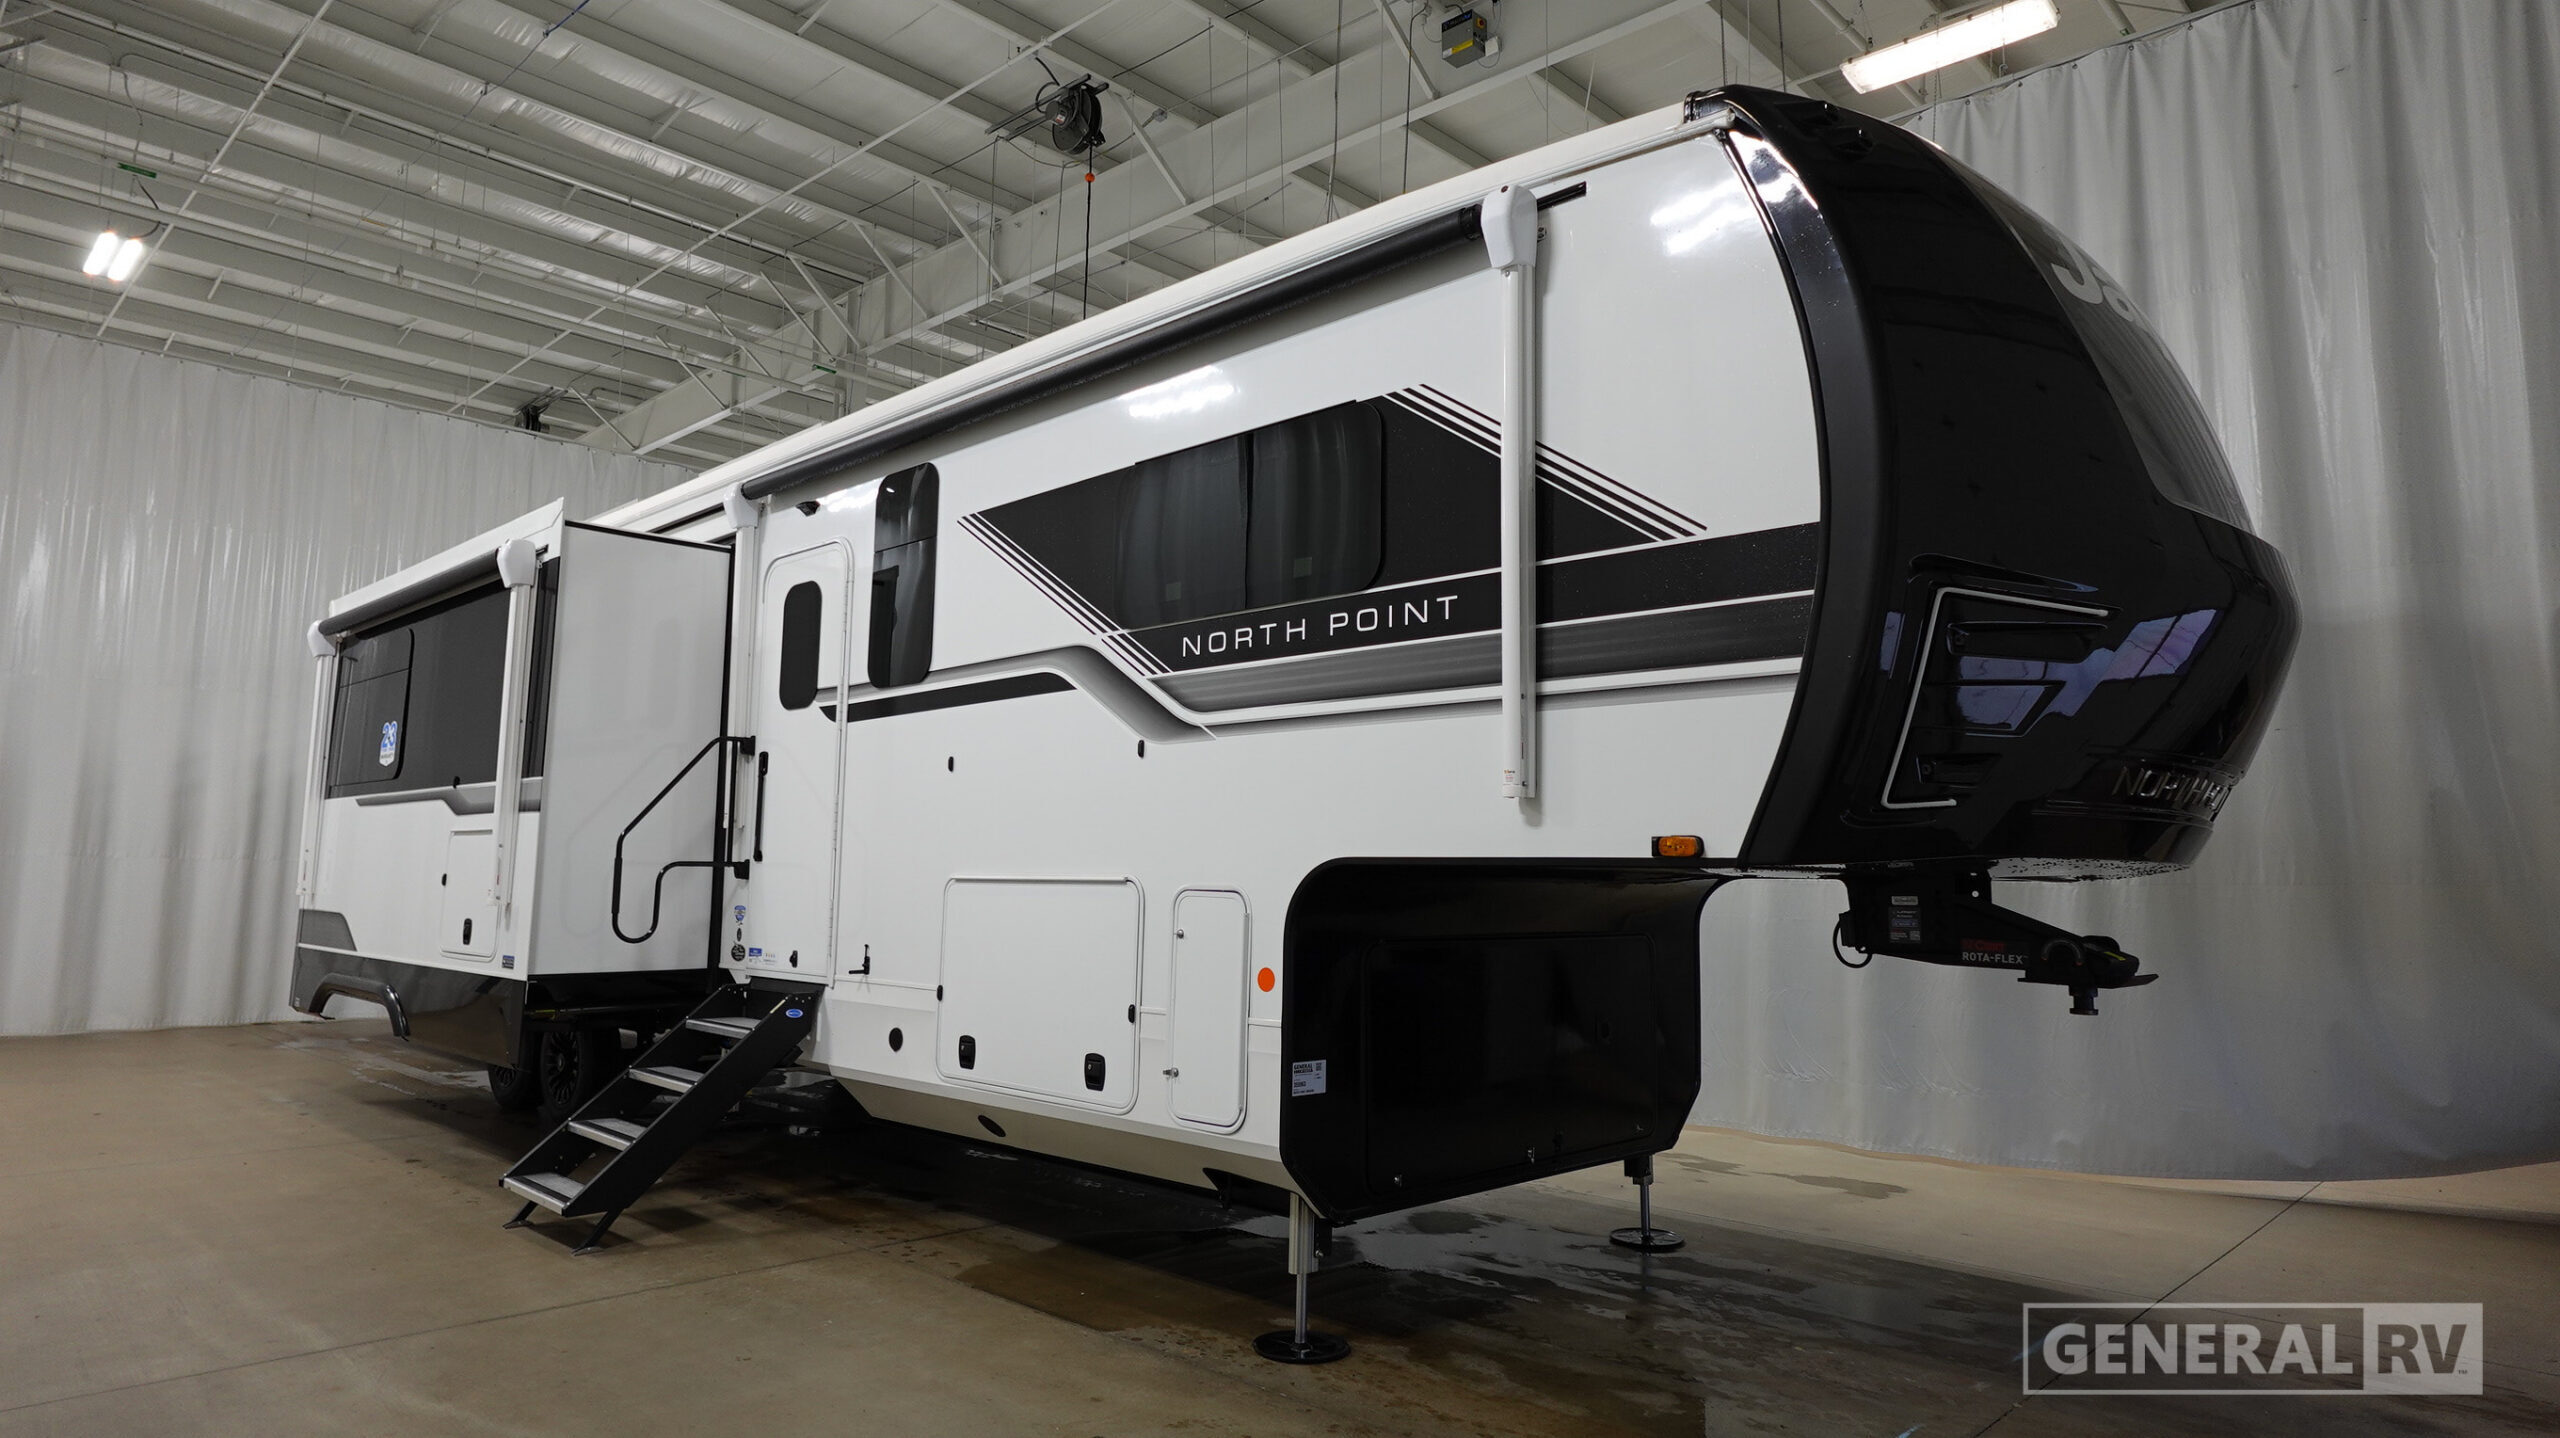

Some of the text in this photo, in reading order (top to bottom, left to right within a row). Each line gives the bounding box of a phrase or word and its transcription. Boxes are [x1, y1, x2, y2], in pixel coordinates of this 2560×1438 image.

[1182, 595, 1458, 658] NORTH POINT
[1961, 951, 2024, 965] ROTA-FLEX
